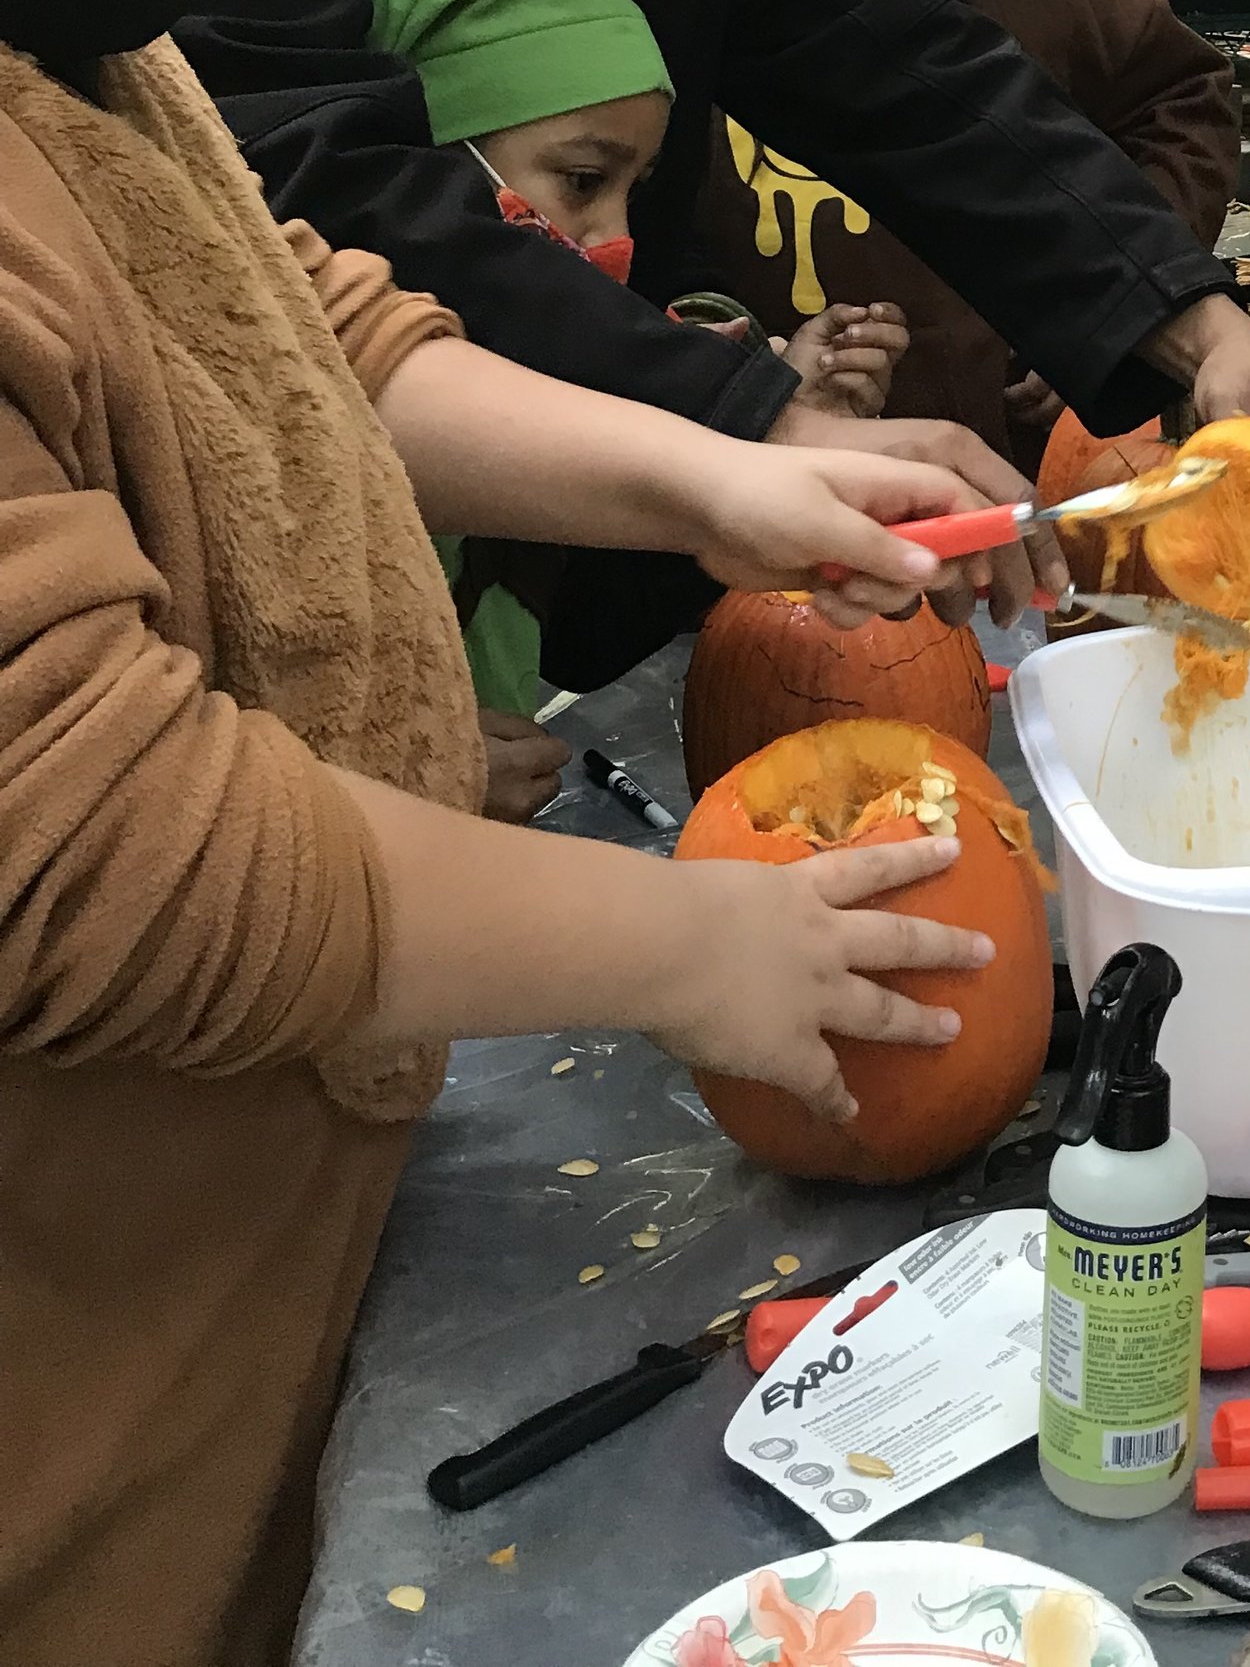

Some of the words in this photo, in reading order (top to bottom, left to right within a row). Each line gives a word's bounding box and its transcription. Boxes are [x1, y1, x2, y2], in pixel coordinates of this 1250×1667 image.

[1074, 1246, 1181, 1282] MEYER'S
[1071, 1278, 1135, 1298] CLEAN
[1148, 1278, 1181, 1296] DAY
[1088, 1322, 1119, 1333] PLEASE
[760, 1344, 854, 1416] EXPO
[801, 1411, 833, 1429] Product
